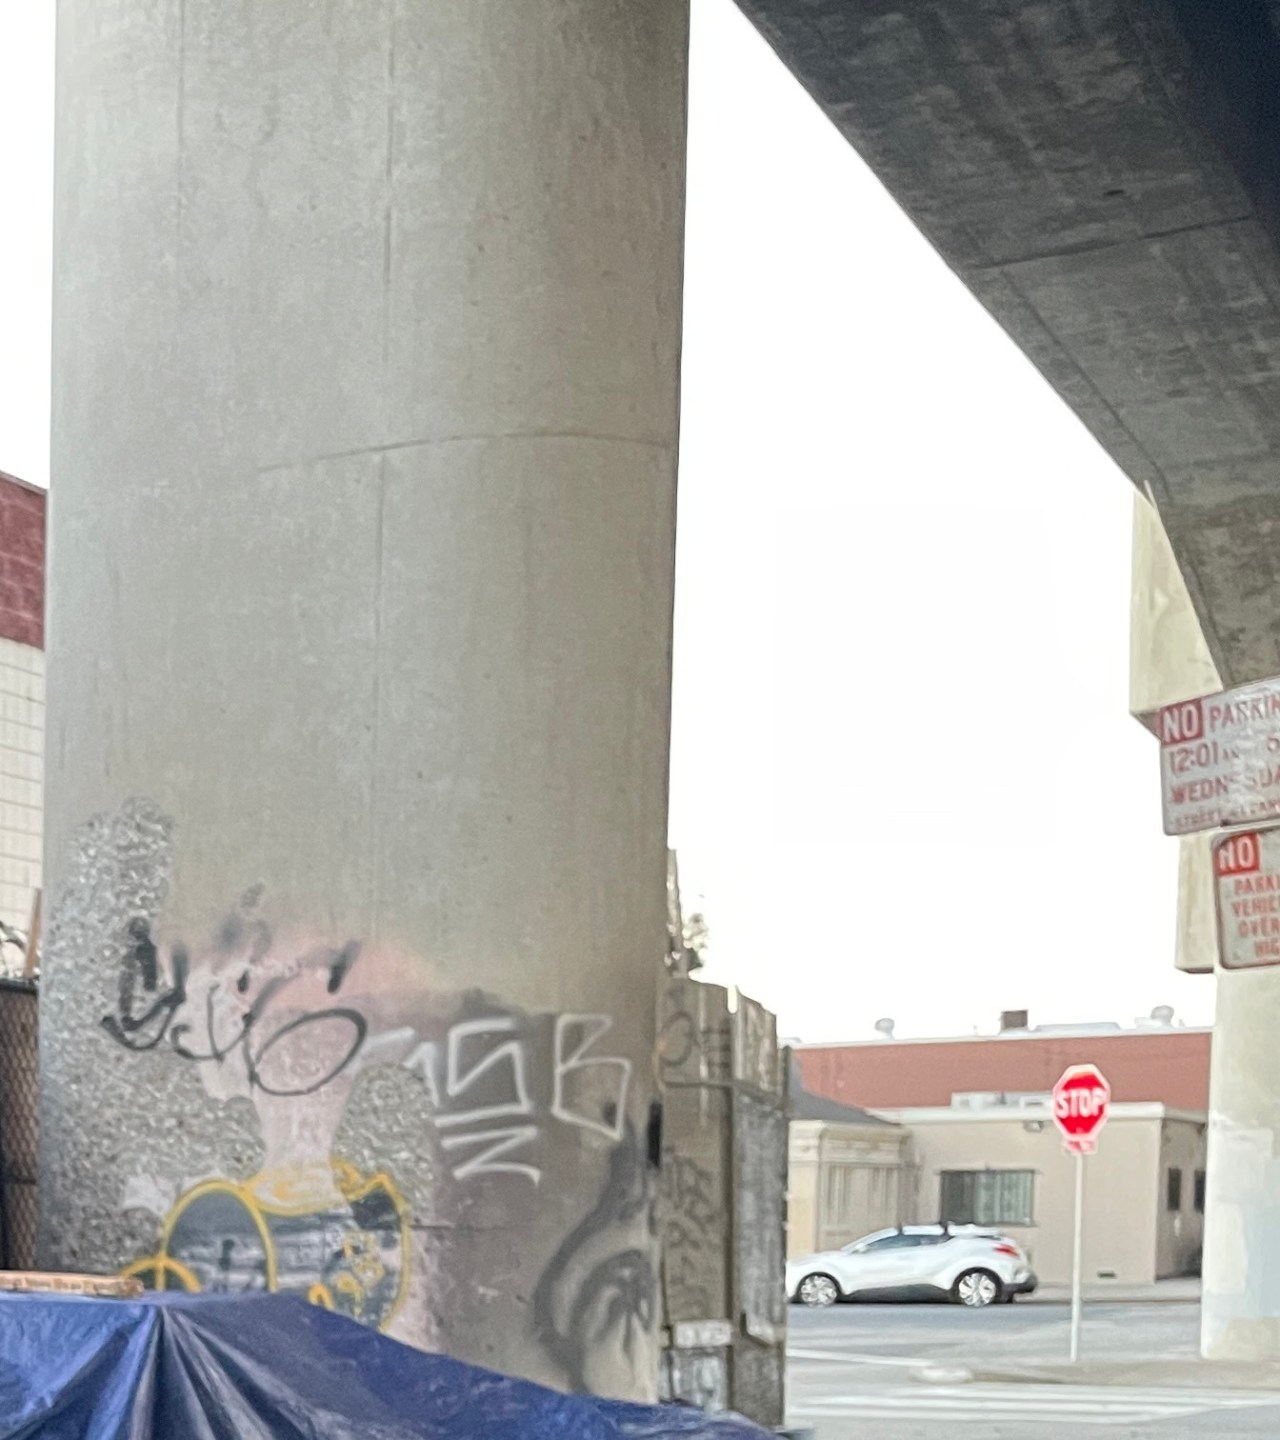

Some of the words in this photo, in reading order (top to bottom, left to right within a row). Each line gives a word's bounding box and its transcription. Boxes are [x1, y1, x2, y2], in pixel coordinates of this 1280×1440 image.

[1162, 703, 1198, 742] NO
[1170, 741, 1220, 776] 12:01
[1218, 835, 1255, 871] NO
[1057, 1089, 1106, 1118] STOP
